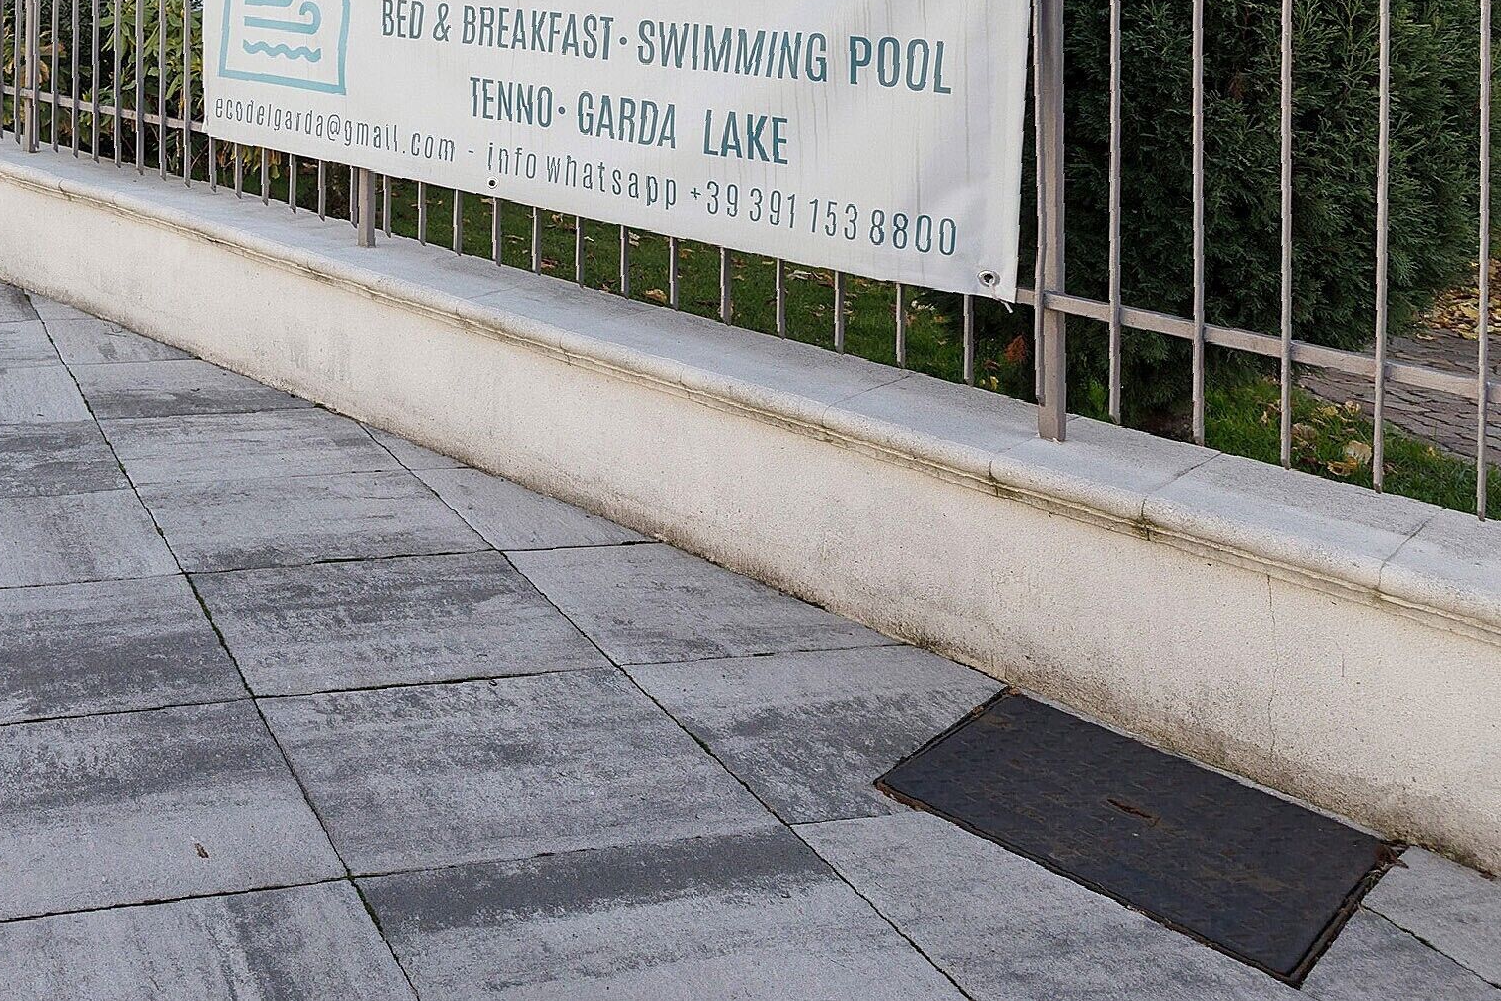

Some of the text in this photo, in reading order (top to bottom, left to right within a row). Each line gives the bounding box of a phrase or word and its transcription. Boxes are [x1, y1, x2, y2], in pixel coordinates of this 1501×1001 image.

[381, 0, 425, 40] BED
[432, 2, 451, 42] &
[636, 19, 828, 83] SWIMMING
[849, 34, 952, 95] POOL
[577, 90, 677, 149] GARDA
[703, 108, 789, 166] LAKE
[214, 97, 455, 163] ecodelgarda@gmail.com
[487, 142, 537, 180] info
[545, 154, 678, 211] whatsapp
[868, 209, 957, 256] 8800
